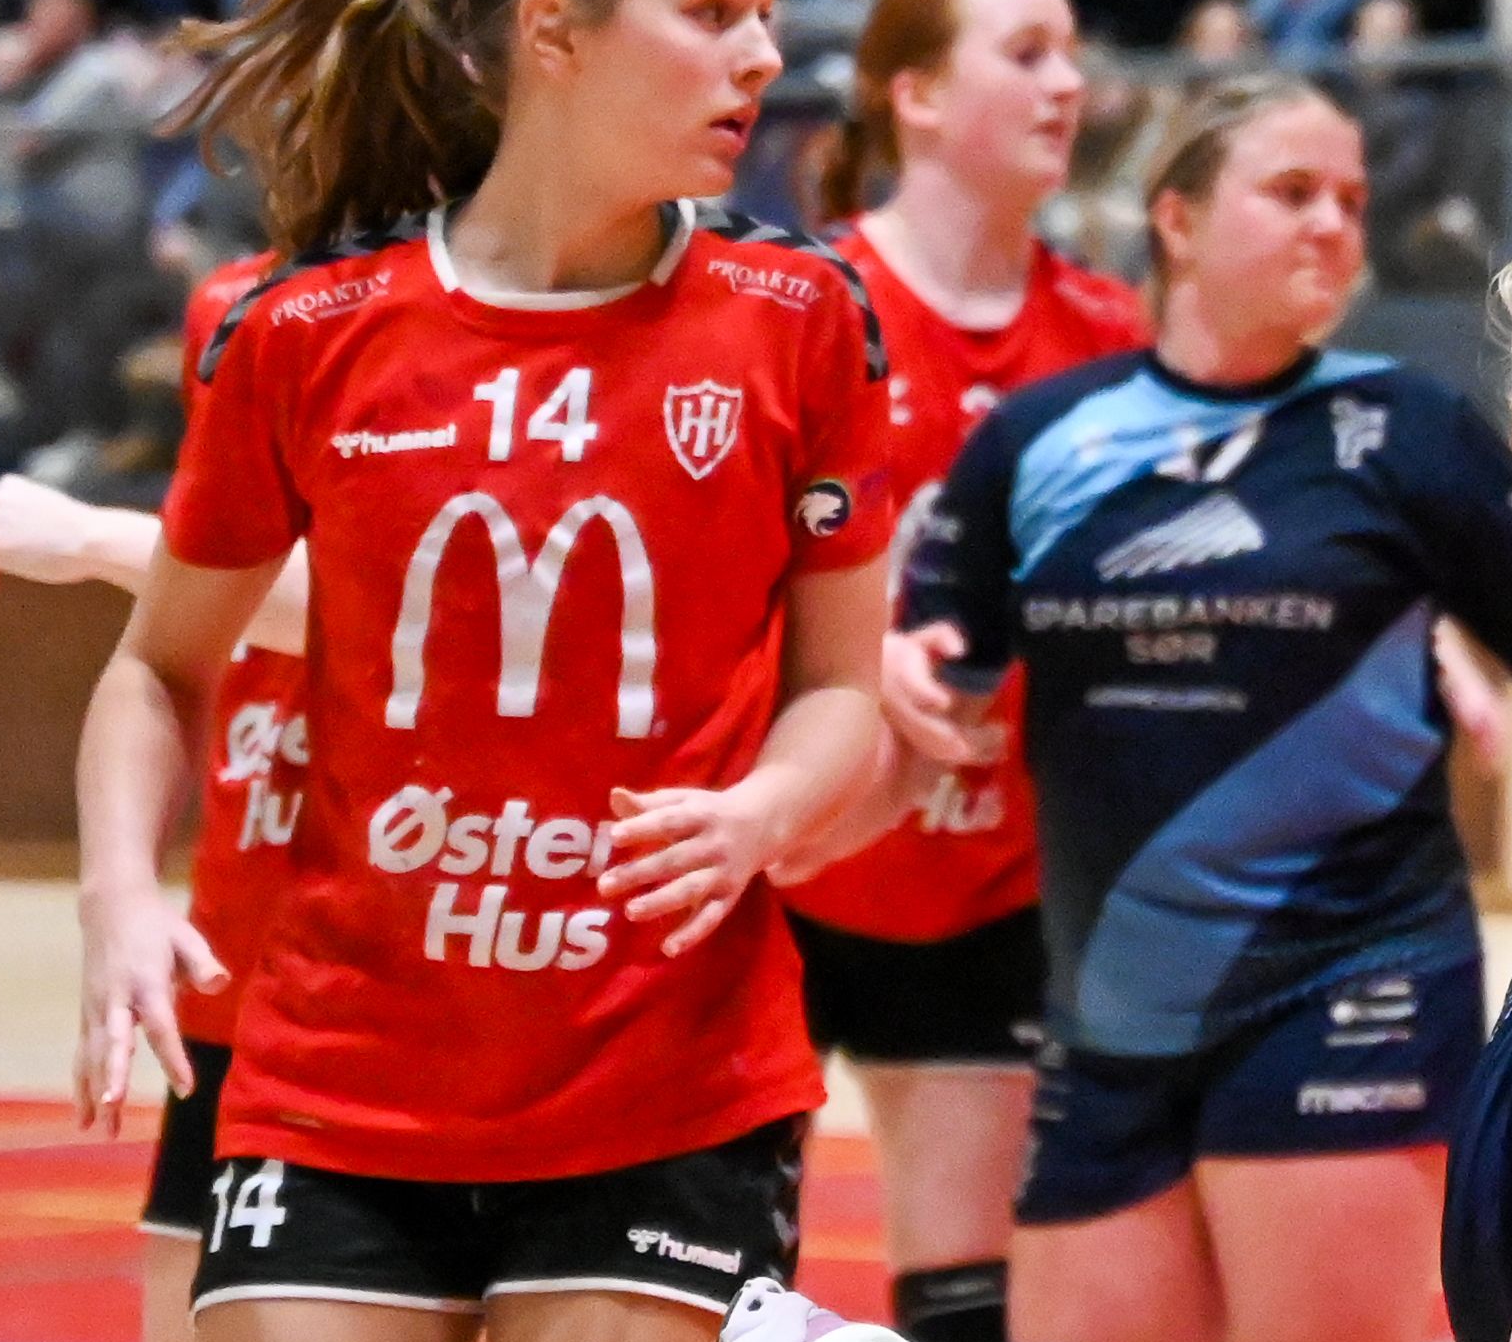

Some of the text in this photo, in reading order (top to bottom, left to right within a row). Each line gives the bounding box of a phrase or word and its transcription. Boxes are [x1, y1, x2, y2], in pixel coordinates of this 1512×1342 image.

[707, 260, 822, 302] PROAKTIV
[358, 422, 457, 456] hummel
[472, 367, 599, 462] 14
[424, 882, 611, 972] Hus
[209, 1159, 287, 1254] 14
[657, 1231, 742, 1275] hummel
